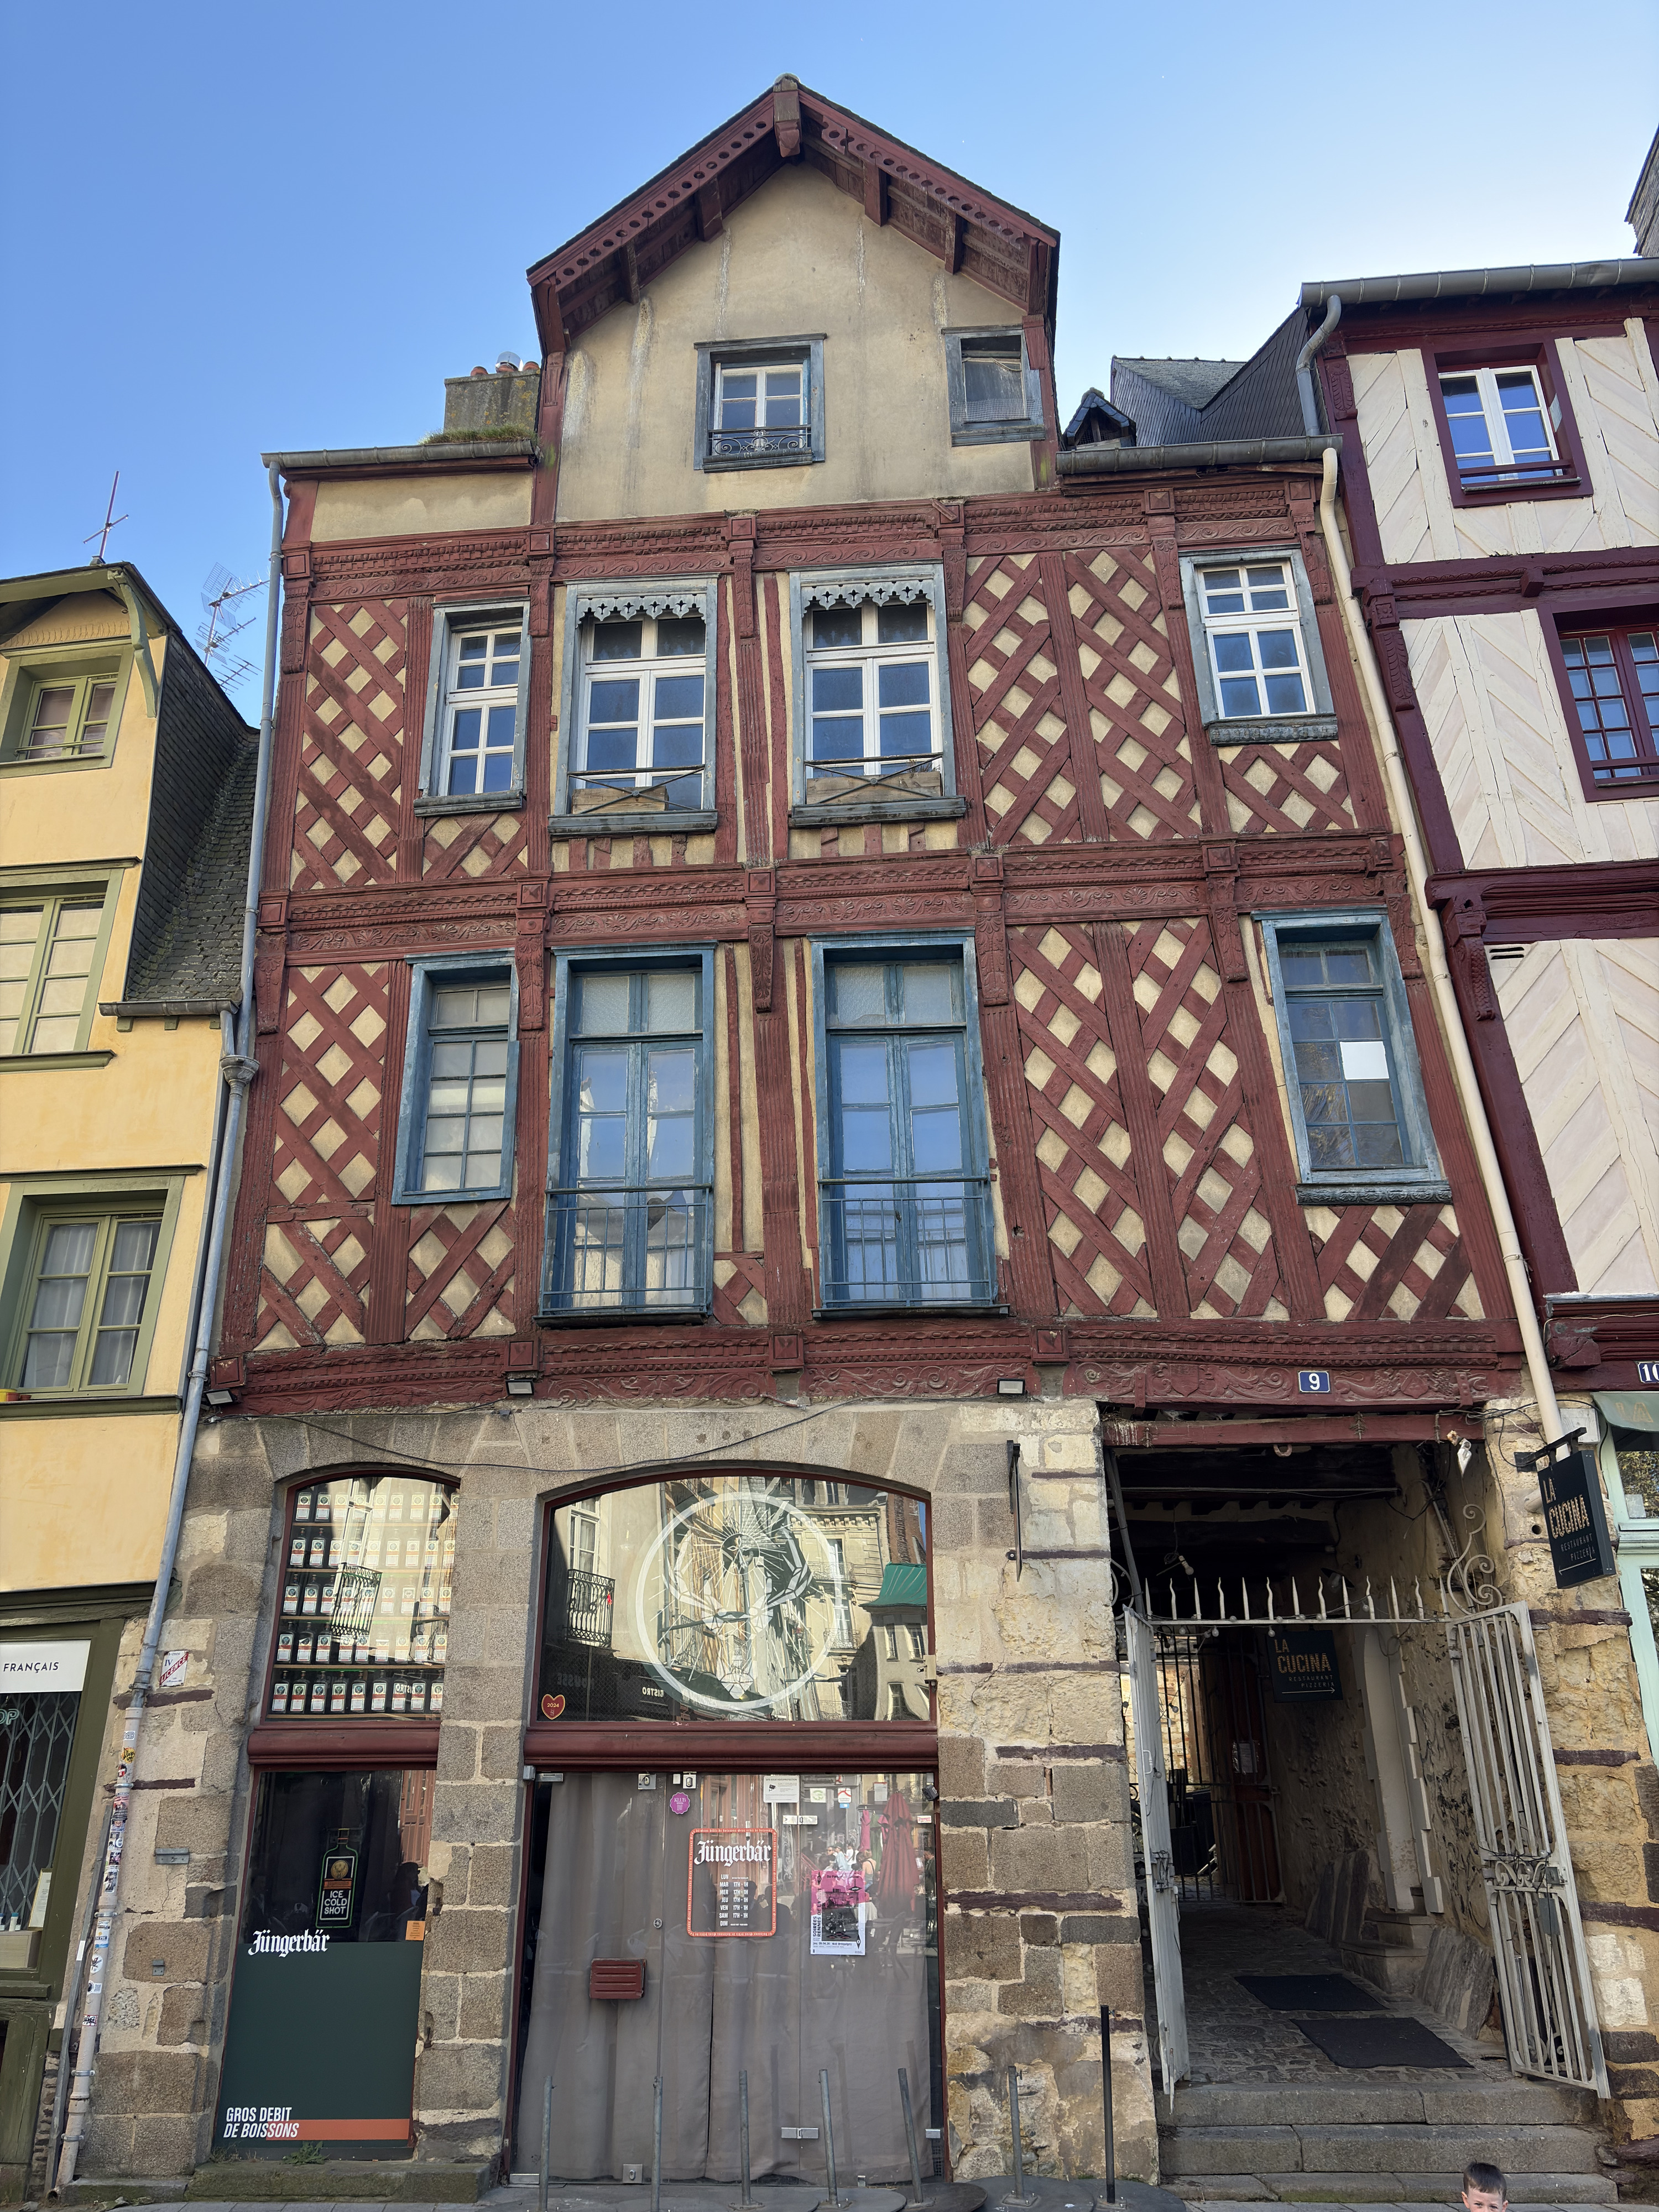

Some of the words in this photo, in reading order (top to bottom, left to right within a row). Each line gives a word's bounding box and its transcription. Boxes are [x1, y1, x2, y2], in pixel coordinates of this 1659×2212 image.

[1308, 1373, 1320, 1390] 9
[1615, 1402, 1653, 1423] LA
[1543, 1477, 1557, 1504] LA
[1549, 1494, 1590, 1540] CUCINA
[1561, 1533, 1593, 1552] RESTAURANT
[1571, 1545, 1596, 1562] PIZZERIA
[1274, 1639, 1290, 1653] LA
[3, 1662, 59, 1673] FRANÇAIS
[160, 1655, 187, 1683] LICENCE
[1277, 1653, 1332, 1673] CUCINA
[693, 1839, 771, 1867] Jüngerbär
[248, 1929, 330, 1958] Jüngerbär
[226, 2107, 257, 2122] GROS
[259, 2107, 292, 2122] DEBIT
[223, 2123, 240, 2138] DE
[241, 2122, 299, 2138] BOISSONS
